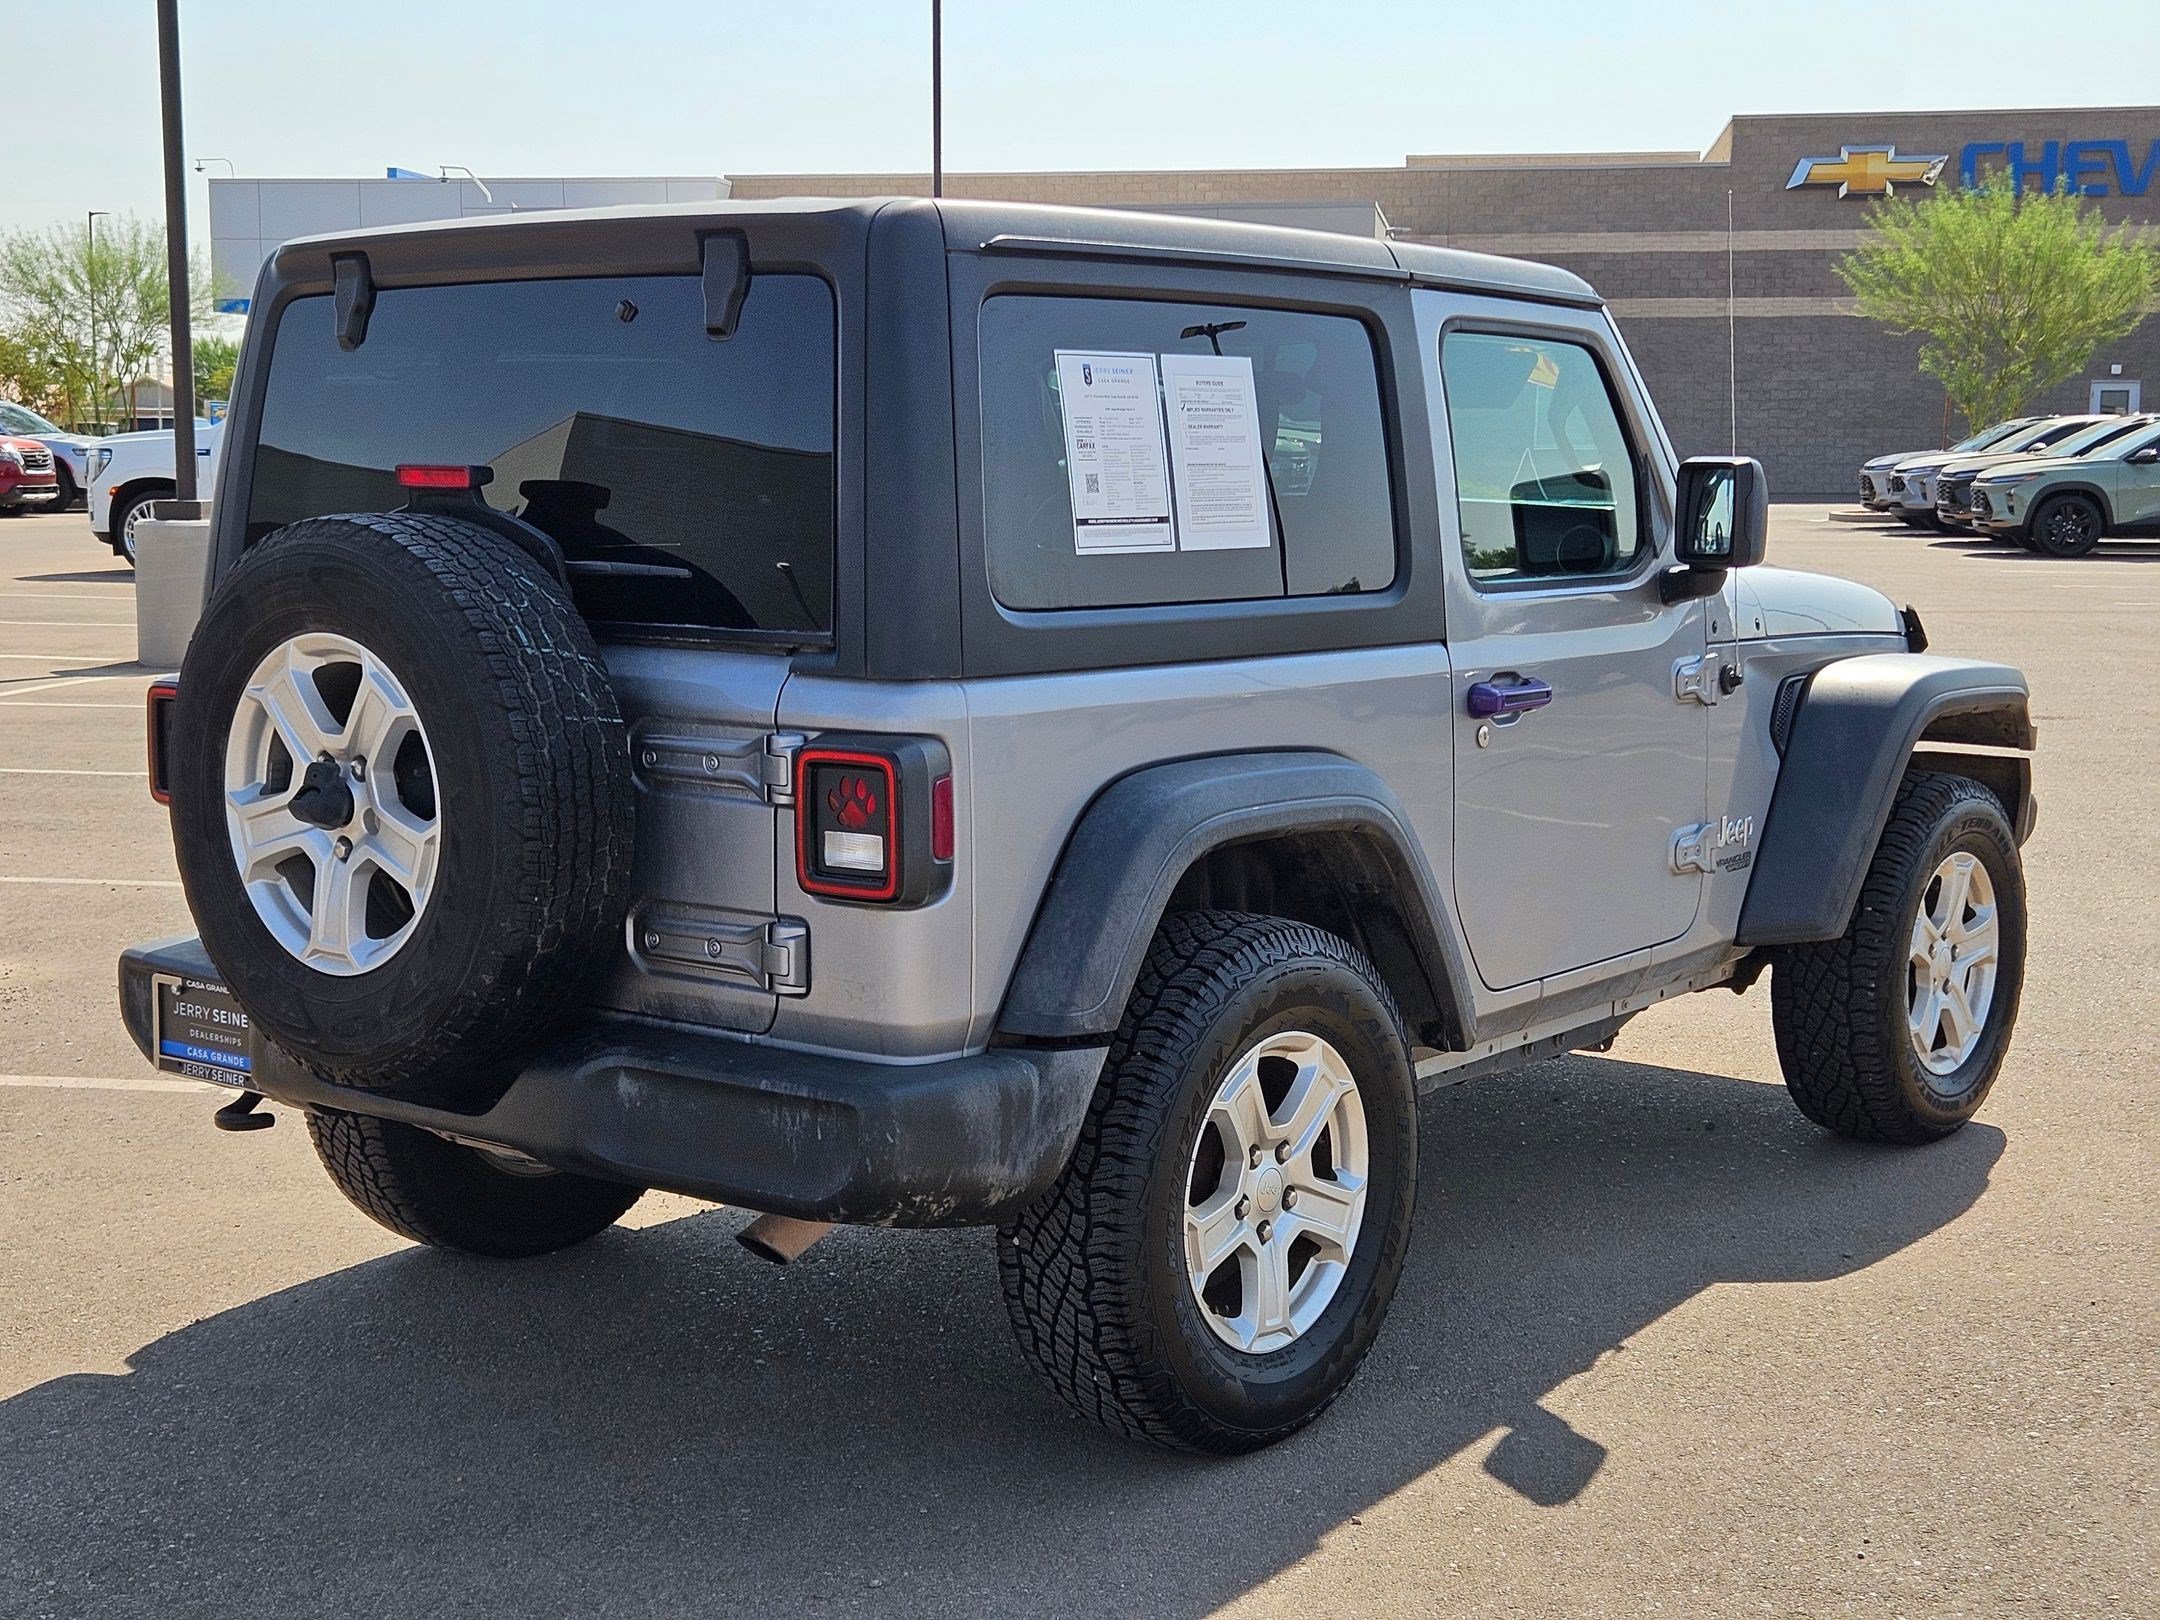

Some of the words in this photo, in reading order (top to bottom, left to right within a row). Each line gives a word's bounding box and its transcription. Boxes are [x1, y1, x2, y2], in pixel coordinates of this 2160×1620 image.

[1717, 815, 1753, 847] Jeep
[186, 980, 206, 989] CASA
[205, 984, 230, 994] GRAN
[173, 1001, 211, 1020] JERRY
[212, 1009, 249, 1028] SEINE
[189, 1028, 242, 1047] DEALERSHIPS
[186, 1047, 209, 1059] CASA
[210, 1051, 244, 1067] GRANDE
[181, 1063, 211, 1078] JERRY
[211, 1069, 245, 1087] SEINER
